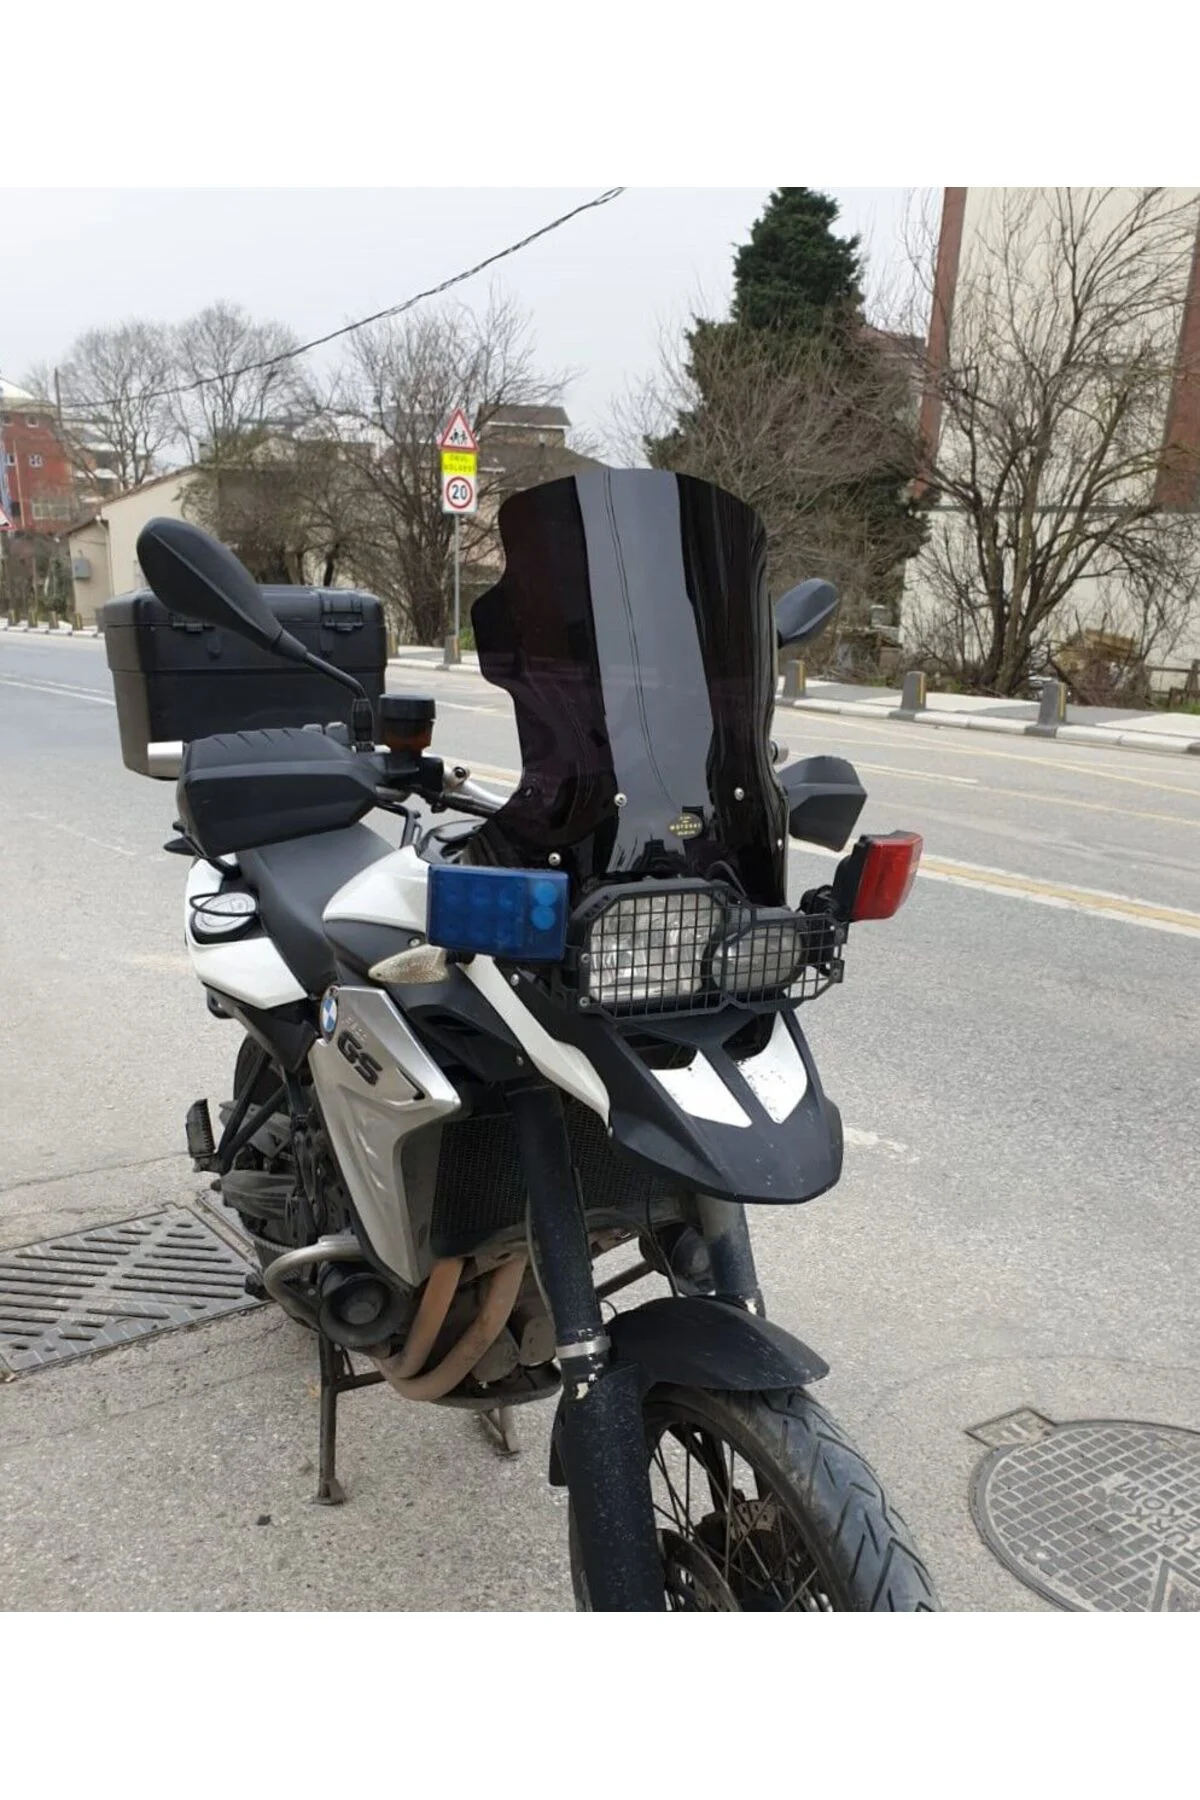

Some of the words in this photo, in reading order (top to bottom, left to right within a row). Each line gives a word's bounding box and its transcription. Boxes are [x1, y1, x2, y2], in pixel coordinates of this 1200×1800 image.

[452, 484, 468, 500] 20
[338, 1031, 383, 1086] GS
[1113, 1481, 1200, 1534] EKOM
